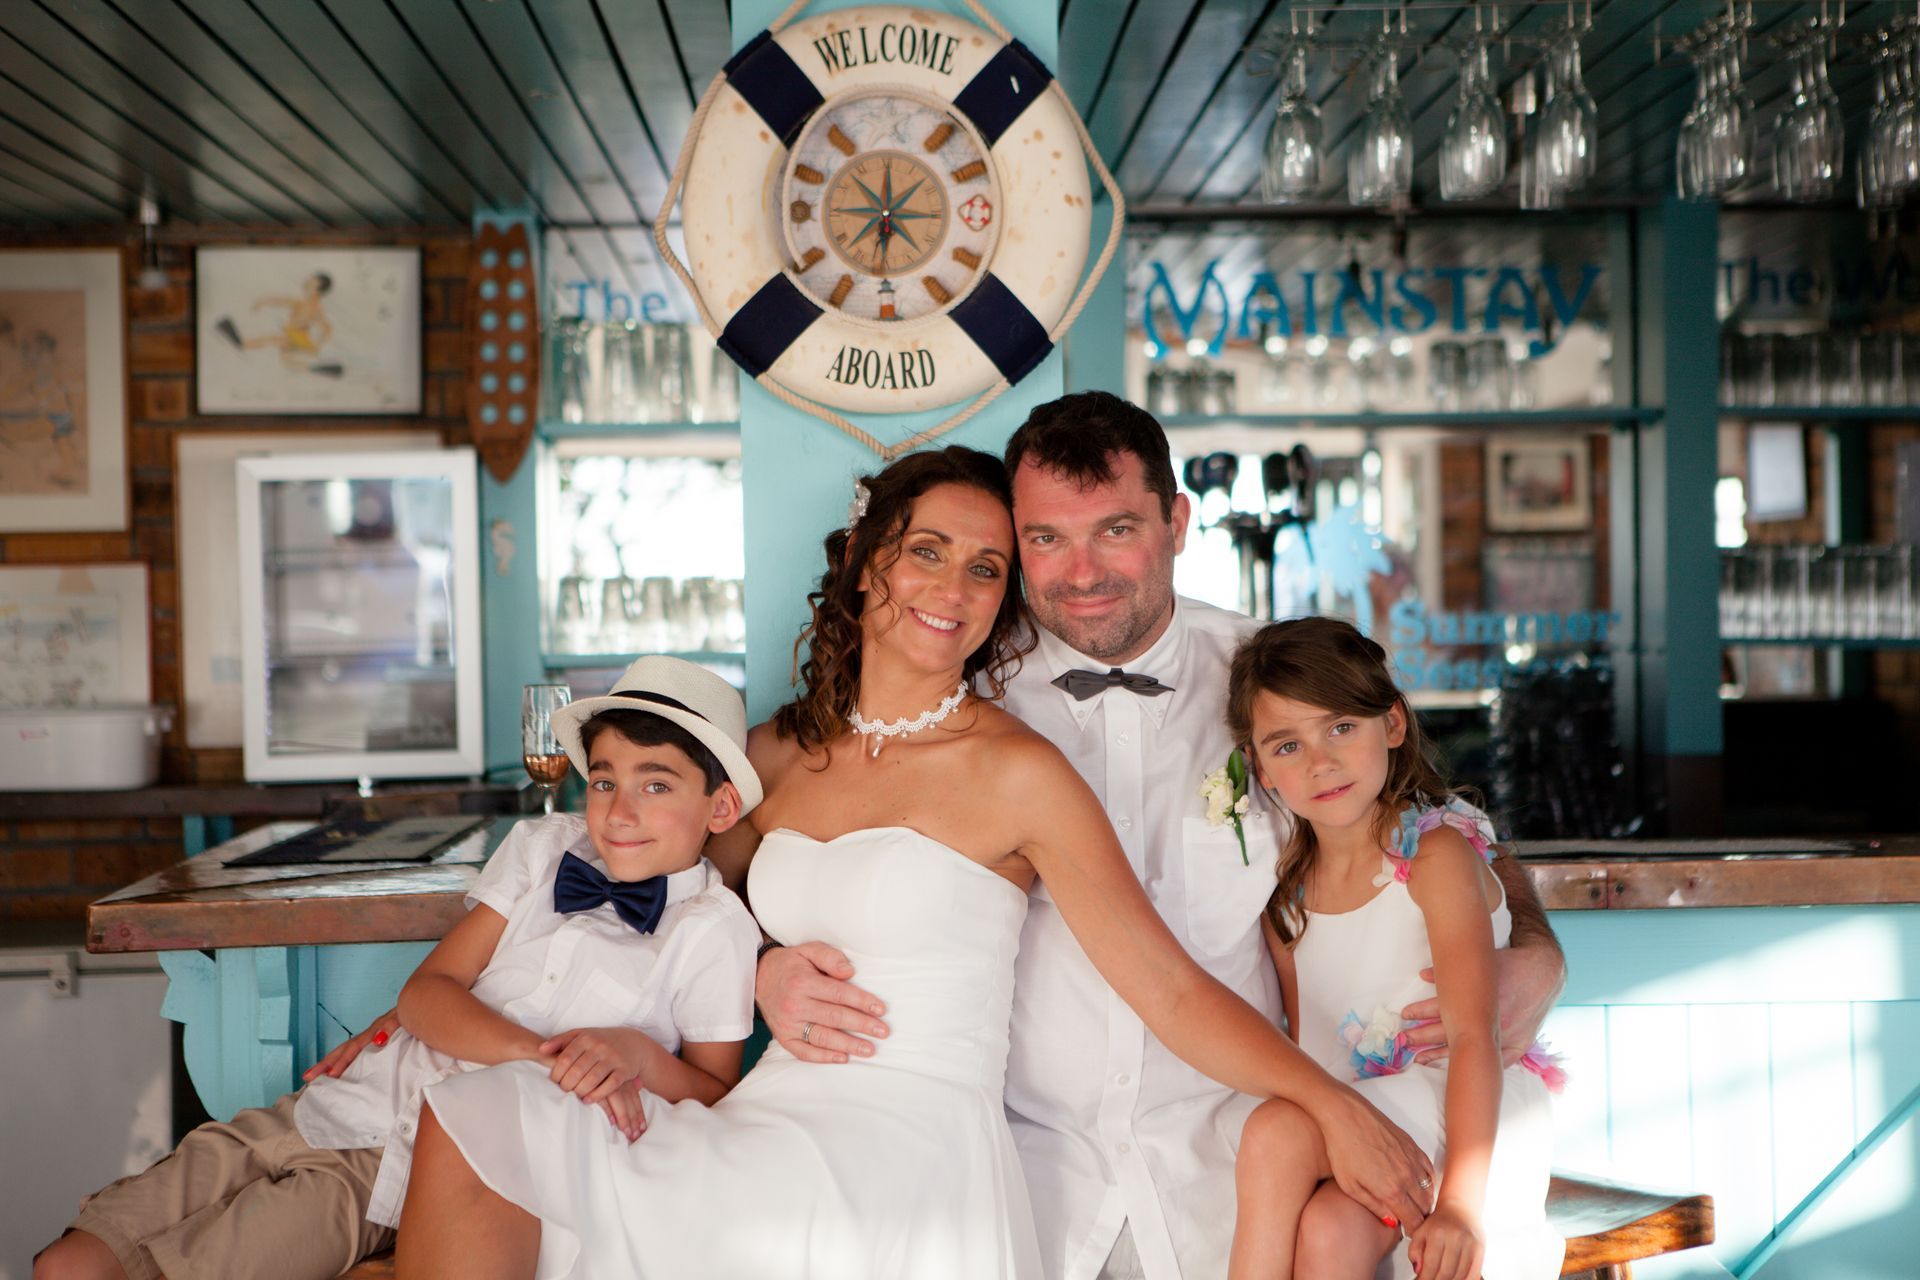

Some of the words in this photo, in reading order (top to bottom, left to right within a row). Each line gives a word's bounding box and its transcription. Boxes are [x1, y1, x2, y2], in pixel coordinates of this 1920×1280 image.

[812, 22, 960, 76] WELCOME
[565, 278, 669, 323] The
[1143, 259, 1602, 360] MAINSTAY
[825, 344, 936, 390] ABOARD
[1389, 600, 1623, 646] Summer
